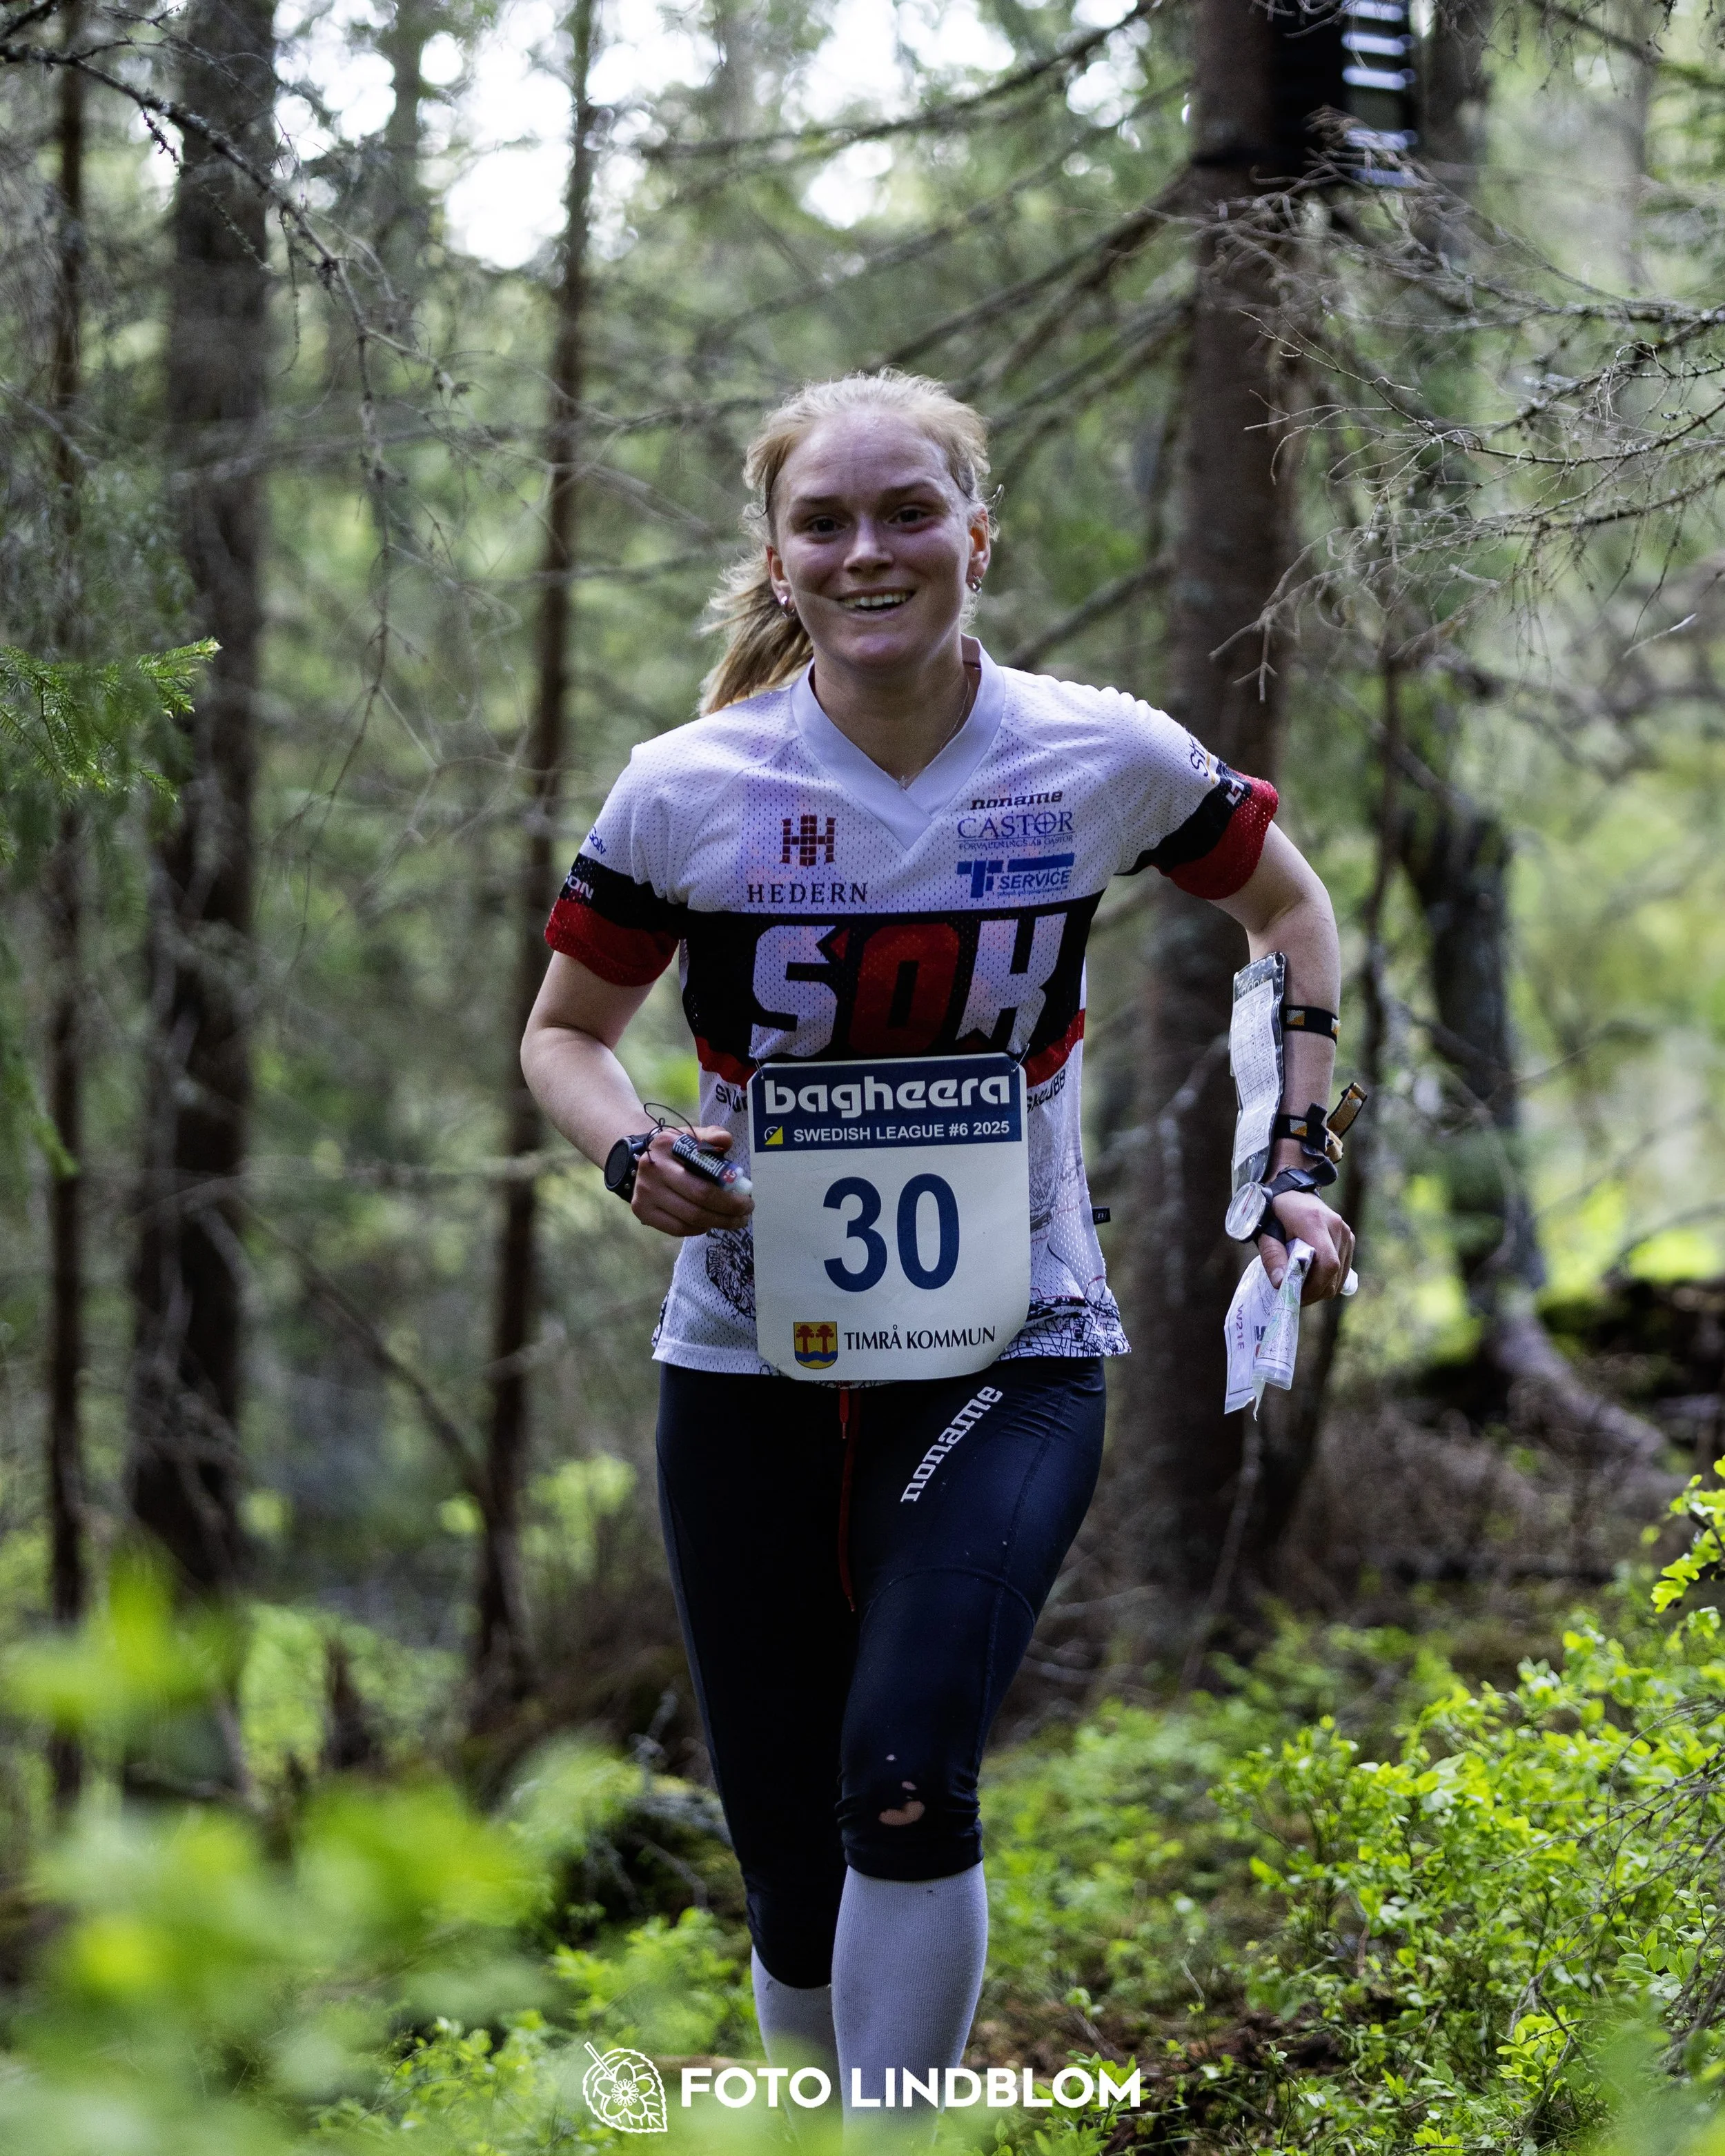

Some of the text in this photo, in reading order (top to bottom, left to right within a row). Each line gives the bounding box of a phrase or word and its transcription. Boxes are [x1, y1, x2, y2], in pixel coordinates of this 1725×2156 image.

[970, 791, 1063, 810] noname
[957, 811, 1074, 839] CASTOR
[1000, 870, 1072, 889] SERVICE
[748, 882, 867, 903] HEDERN
[765, 1076, 1011, 1118] bagheera
[793, 1120, 1010, 1143] SWEDISH LEAGUE #6 2025
[822, 1173, 960, 1292] 30
[844, 1325, 995, 1350] TIMRÅ KOMMUN
[900, 1386, 1003, 1503] noname
